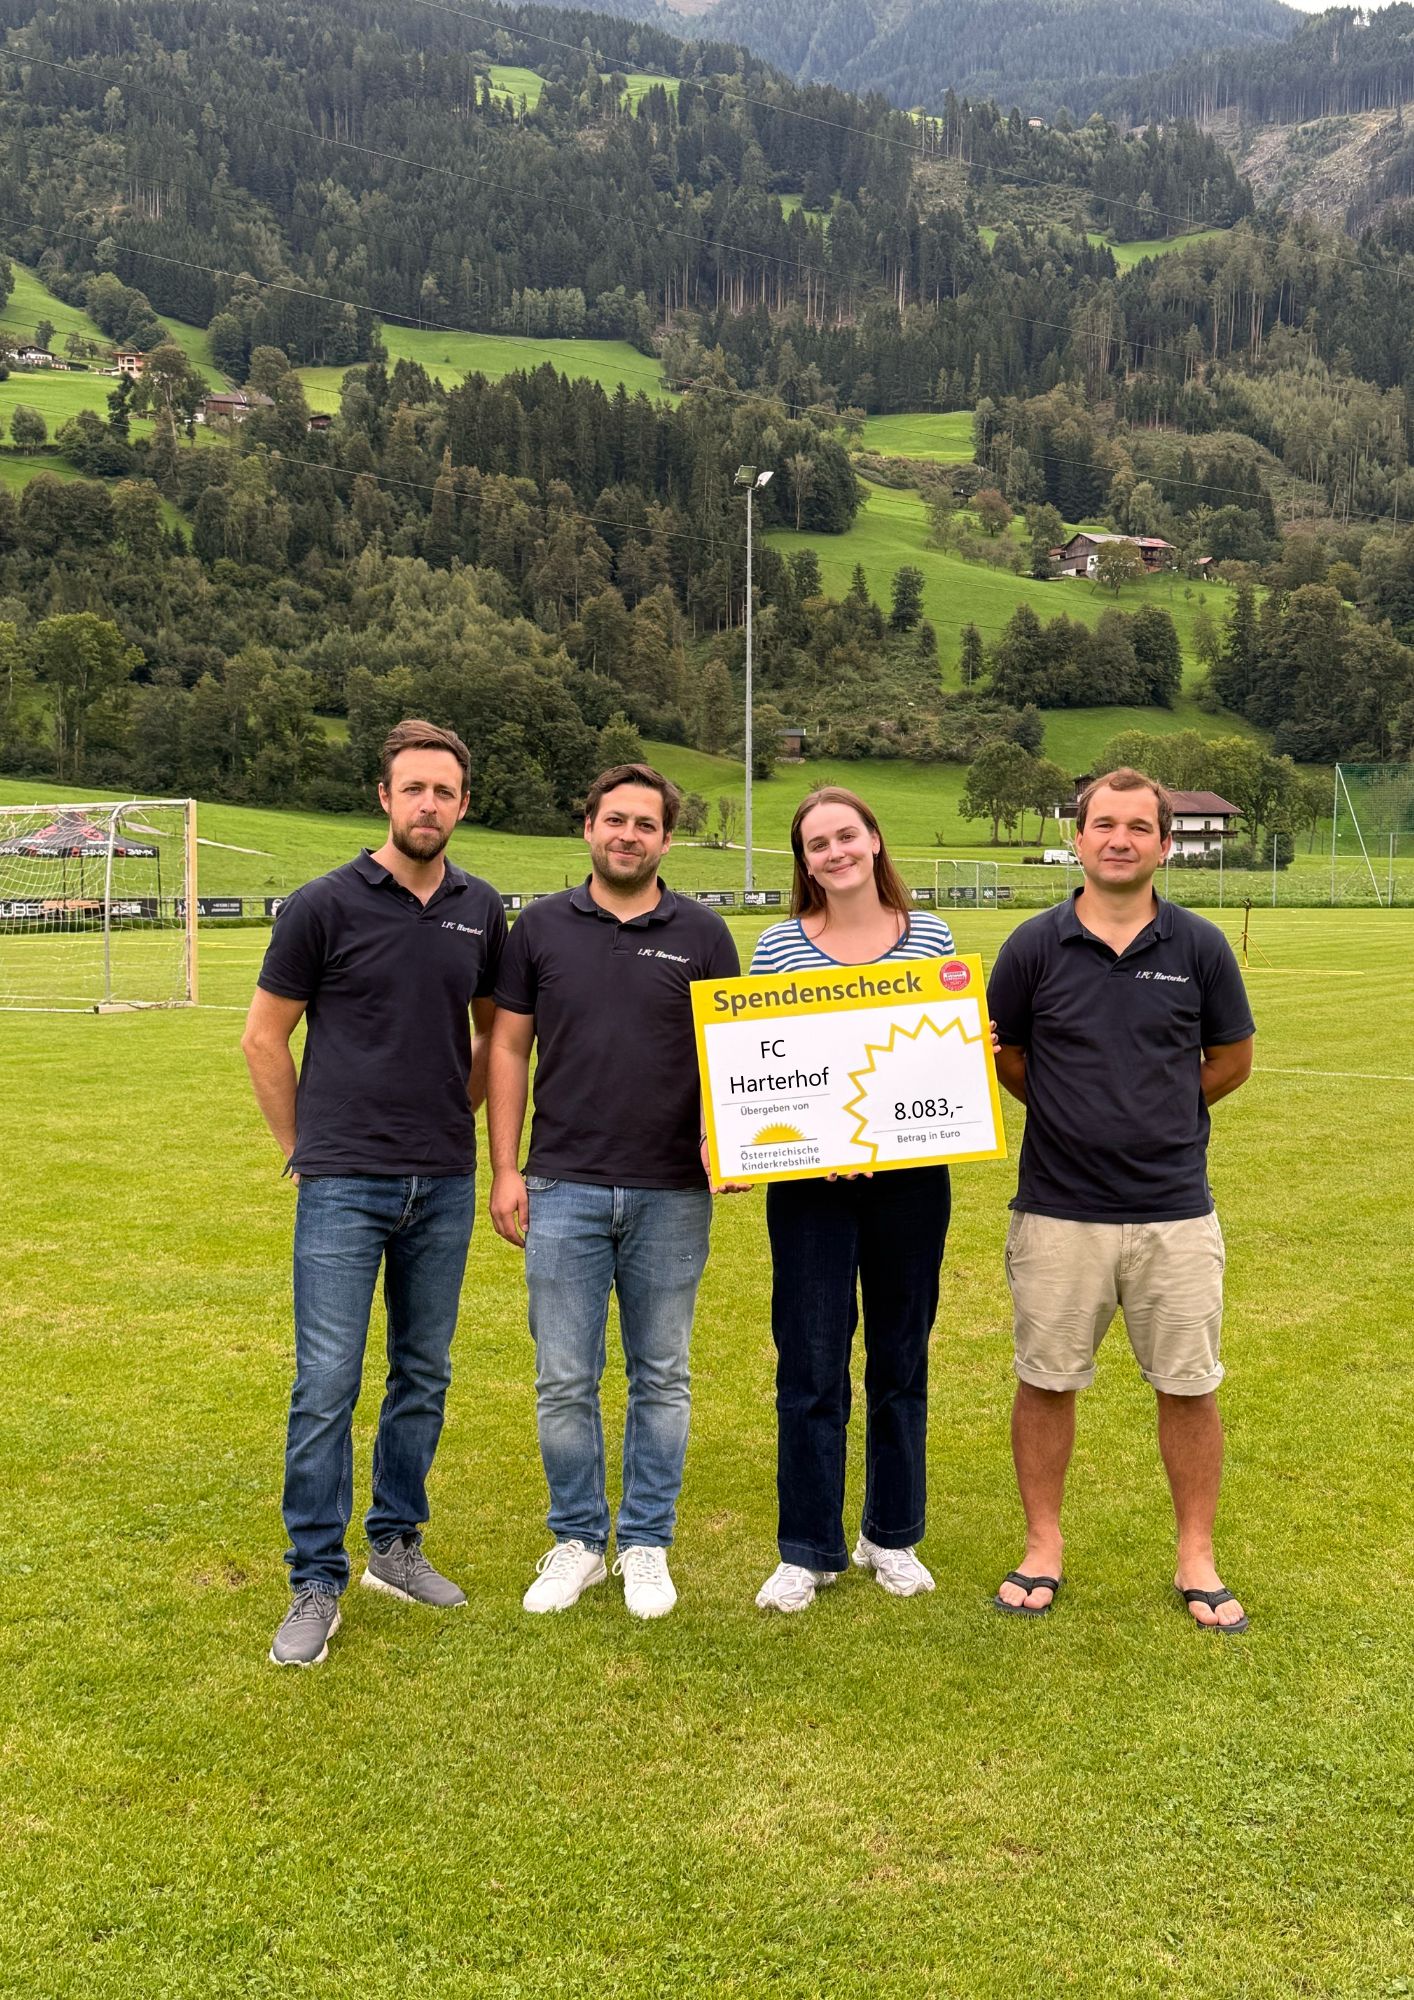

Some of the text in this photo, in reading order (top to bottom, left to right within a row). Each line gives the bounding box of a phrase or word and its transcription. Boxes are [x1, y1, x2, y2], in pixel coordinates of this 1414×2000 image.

[714, 971, 922, 1016] Spendenscheck
[761, 1040, 786, 1059] FC
[730, 1066, 829, 1094] Harterhof
[740, 1102, 809, 1116] Übergeben von
[894, 1098, 963, 1120] 8.083,-
[897, 1130, 960, 1144] Betrag in Euro
[740, 1146, 819, 1160] Österreichische
[742, 1156, 820, 1171] Kinderkrebshilfe
